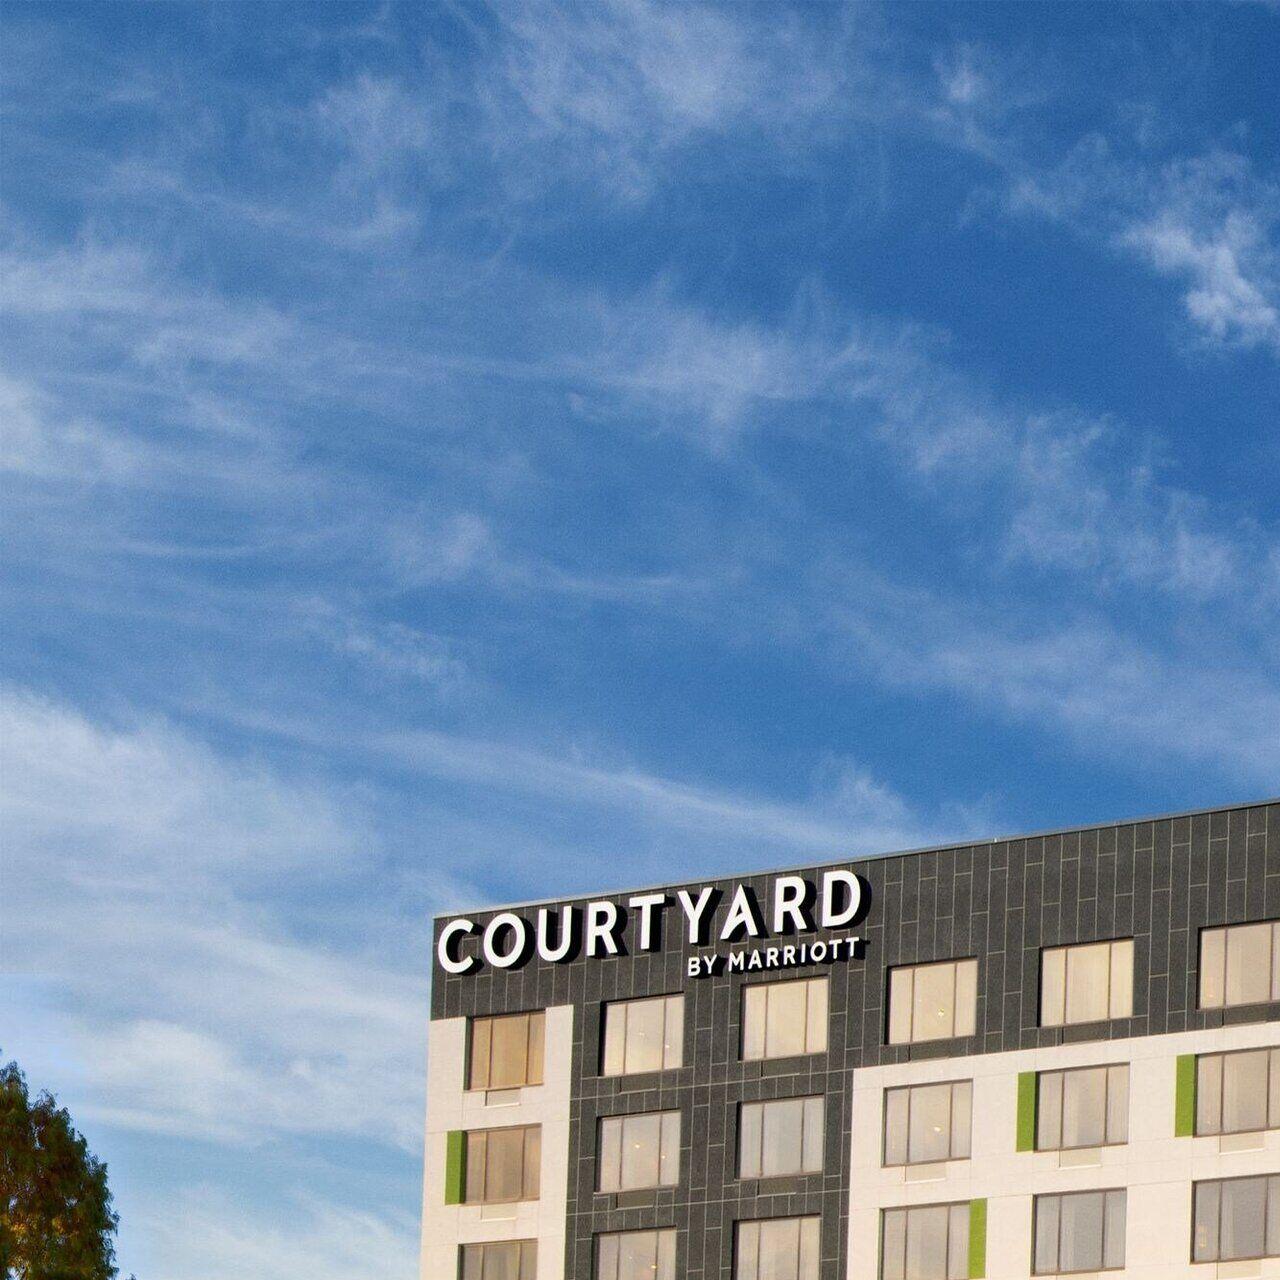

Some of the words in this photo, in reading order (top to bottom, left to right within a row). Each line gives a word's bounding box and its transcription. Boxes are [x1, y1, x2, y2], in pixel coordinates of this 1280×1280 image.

[438, 870, 861, 975] COURTYARD
[687, 953, 716, 977] BY
[728, 937, 860, 972] MARRIOTT
